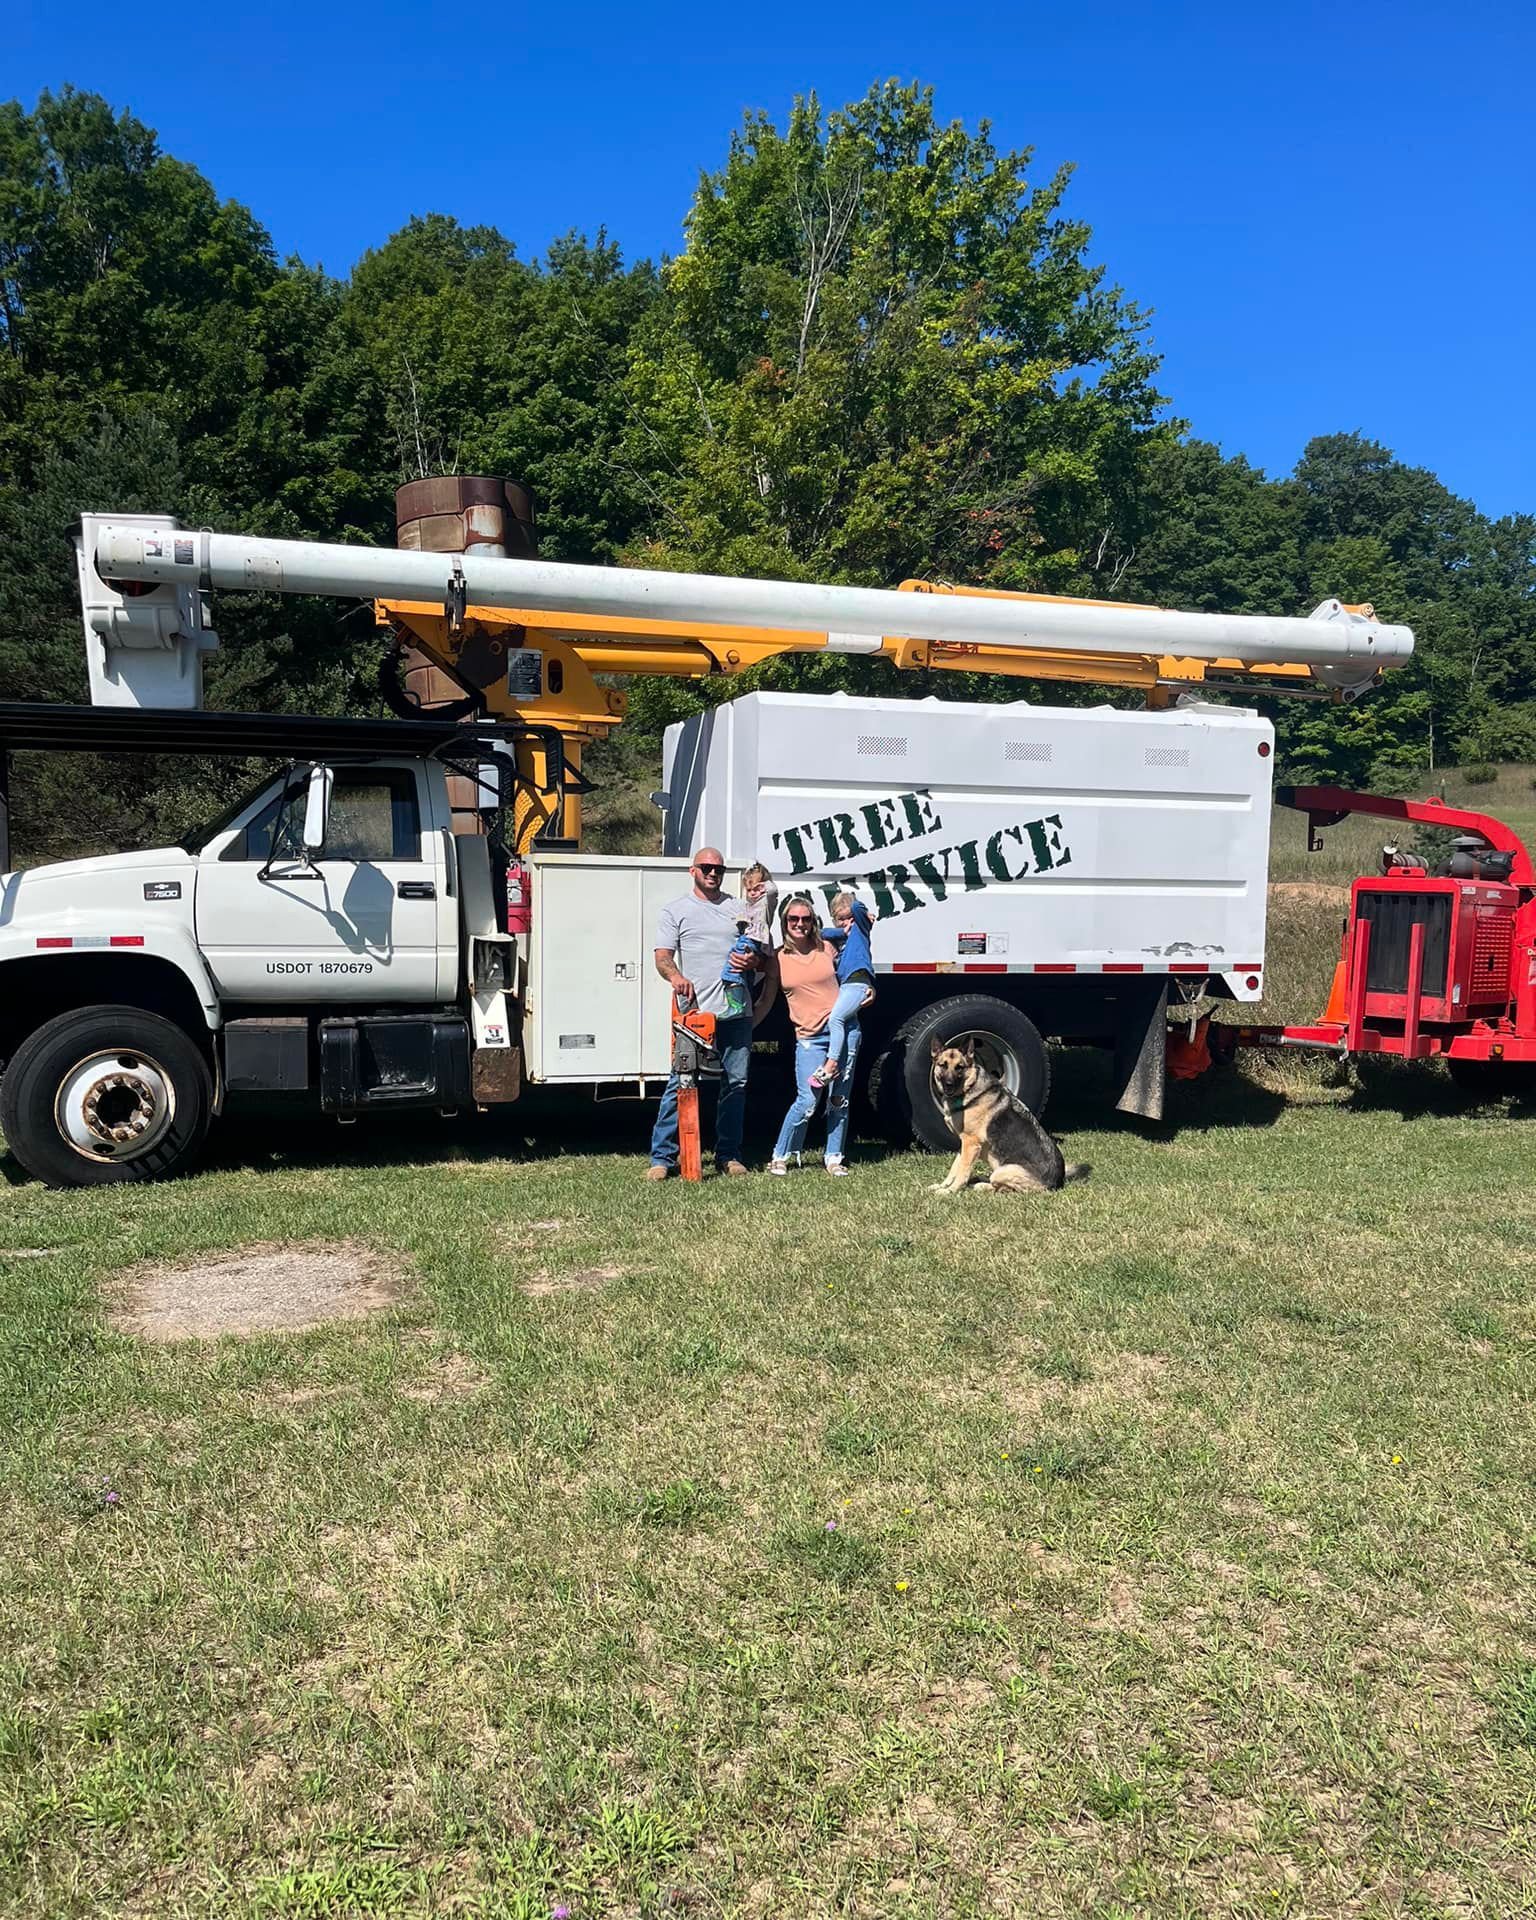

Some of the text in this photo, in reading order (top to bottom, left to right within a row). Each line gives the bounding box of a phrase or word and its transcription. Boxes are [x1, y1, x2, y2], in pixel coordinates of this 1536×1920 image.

[772, 788, 942, 875] TREE
[778, 814, 1072, 929] RVICE
[266, 962, 373, 974] USDOT 1870679
